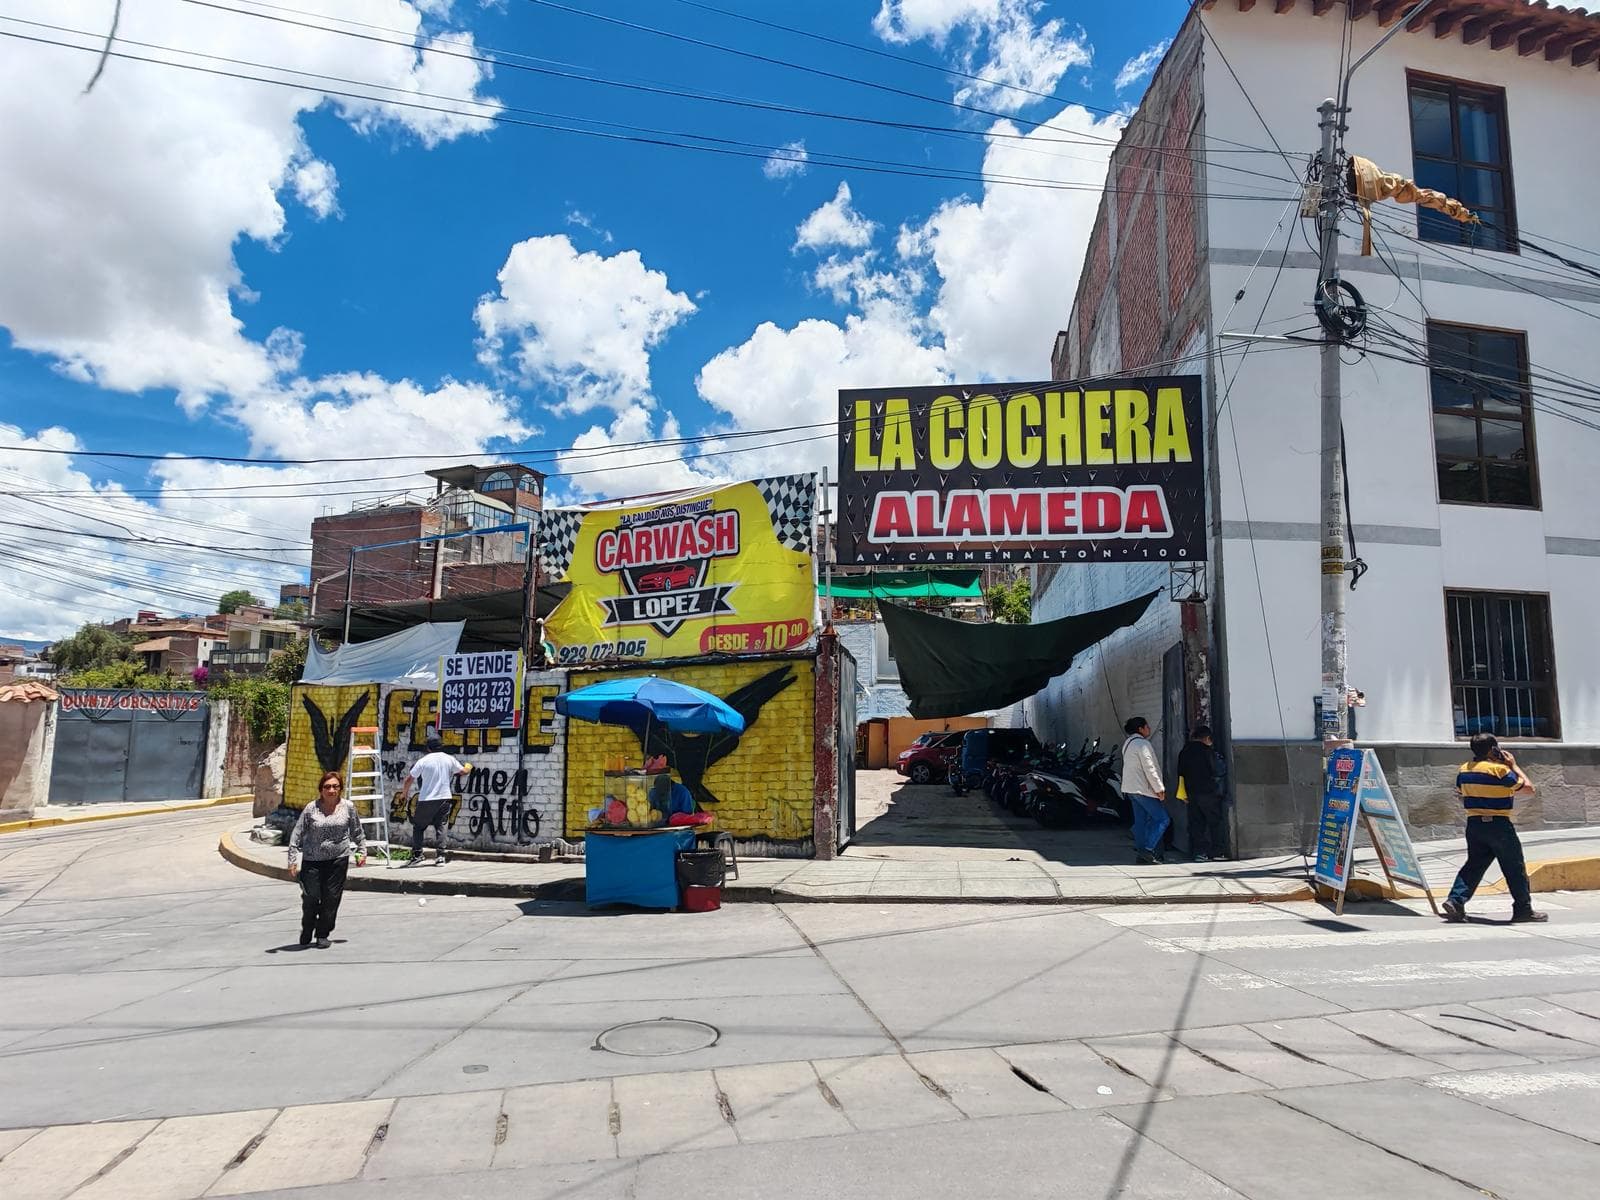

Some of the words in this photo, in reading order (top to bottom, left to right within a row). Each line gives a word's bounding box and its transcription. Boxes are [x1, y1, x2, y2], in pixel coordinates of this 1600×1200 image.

[853, 398, 917, 472] LA
[929, 387, 1194, 471] COCHERA
[872, 488, 1170, 540] ALAMEDA
[598, 514, 736, 569] CARWASH
[632, 592, 700, 619] LOPEZ
[707, 632, 750, 651] DESDE
[446, 657, 462, 676] SE
[467, 654, 513, 675] VENDE
[559, 646, 588, 664] 929
[445, 683, 465, 698] 943
[467, 682, 488, 698] 012
[491, 680, 511, 696] 723
[445, 699, 464, 714] 994
[467, 697, 487, 713] 829
[490, 697, 511, 713] 947
[468, 794, 543, 838] Alto
